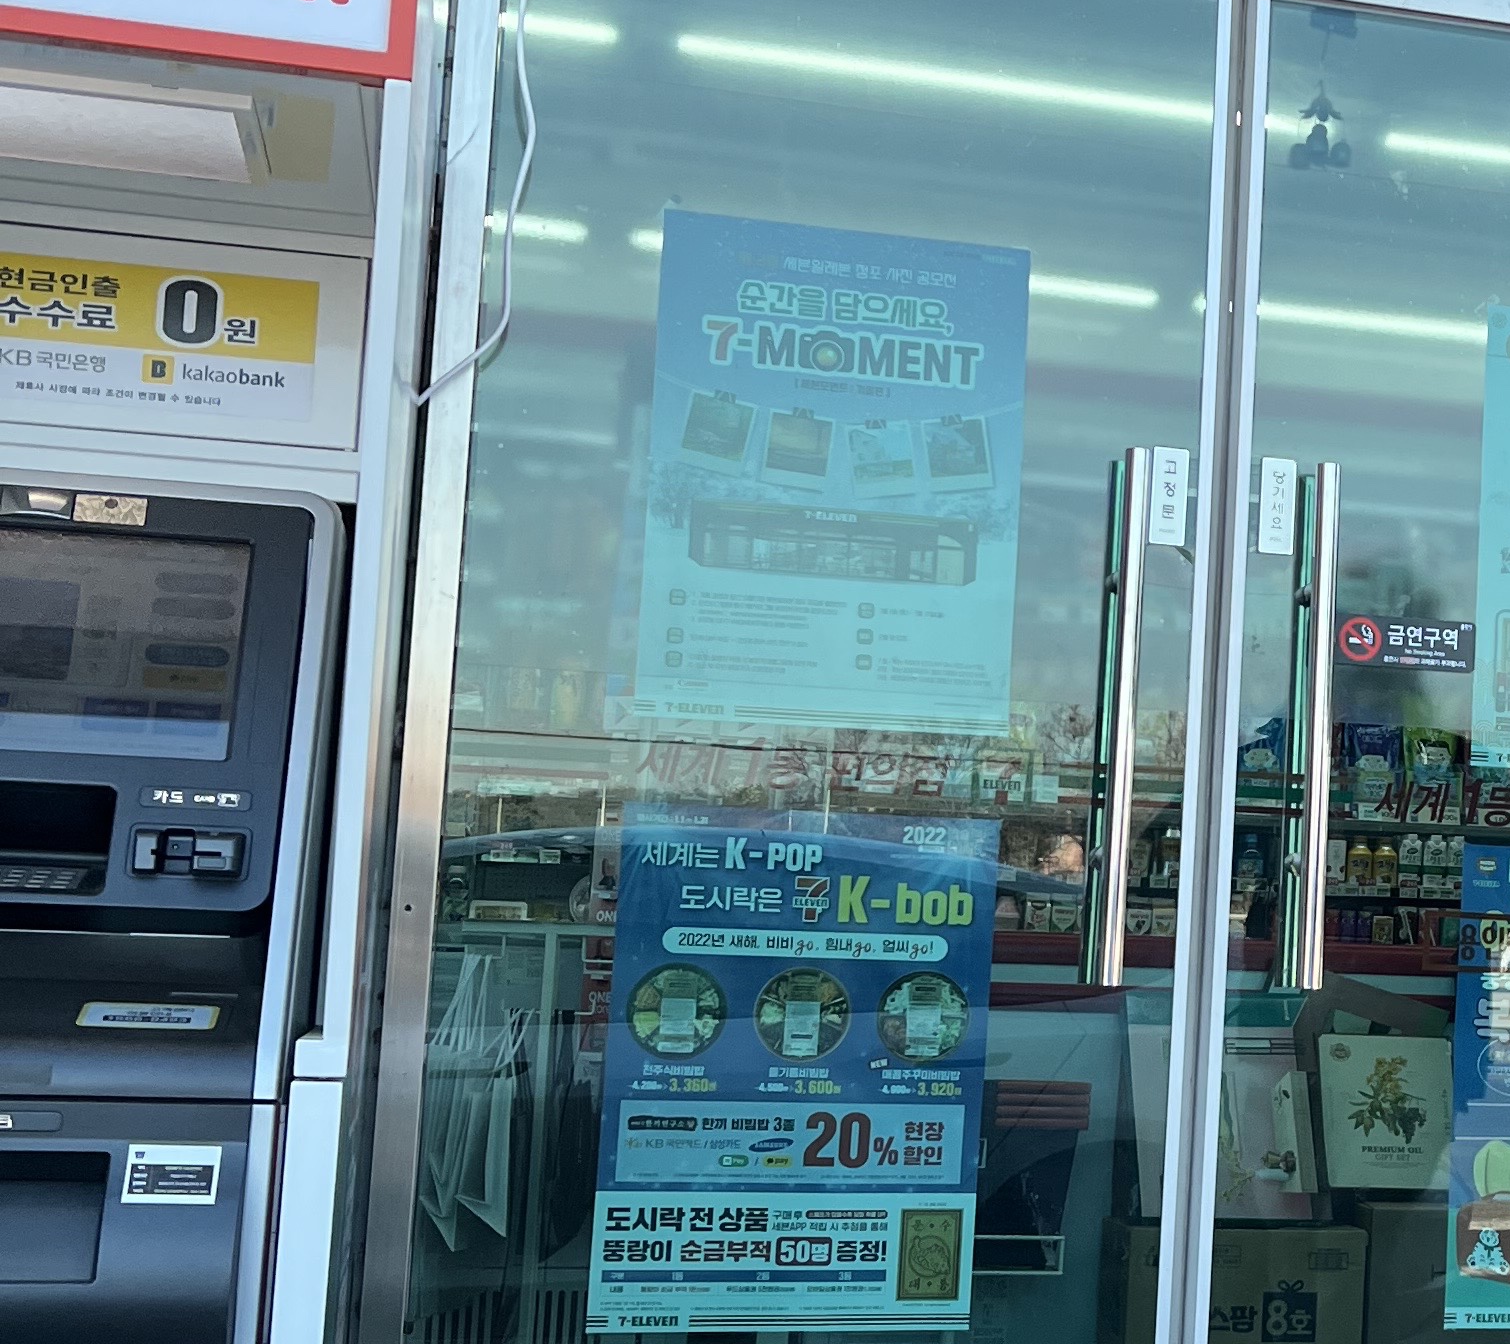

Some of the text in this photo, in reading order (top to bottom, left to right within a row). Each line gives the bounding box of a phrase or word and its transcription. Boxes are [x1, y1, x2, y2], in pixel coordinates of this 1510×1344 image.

[0, 267, 120, 298] 현금인출
[783, 257, 851, 278] 세븐일레븐
[885, 267, 912, 284] 사진
[0, 296, 115, 328] 수수료
[163, 280, 256, 344] 0원
[739, 280, 953, 336] 순간을 담으세요,
[37, 352, 106, 373] 국민은행
[182, 363, 285, 388] kakaobank
[170, 393, 179, 403] 수
[1162, 459, 1178, 520] 고정문
[1270, 470, 1287, 531] 당기세요
[1387, 624, 1459, 651] 금연구역
[152, 789, 184, 804] 카드
[1374, 782, 1450, 824] 세계
[903, 825, 946, 845] 2022
[641, 836, 823, 872] 세계는 K-POP
[679, 875, 974, 926] 도시락은 K-bob
[678, 931, 724, 948] 2022년
[731, 1118, 770, 1131] 비빔밥
[904, 1120, 945, 1142] 현장
[645, 1139, 664, 1149] KB
[803, 1111, 899, 1169] 20%
[1361, 1145, 1424, 1154] PREMIUM OIL
[903, 1145, 944, 1166] 할인
[605, 1207, 769, 1233] 도시락 전 상품
[772, 1222, 806, 1232] 세븐APP
[809, 1222, 827, 1232] 적립
[830, 1222, 839, 1232] 시
[603, 1239, 887, 1263] 뚱랑이 순금부적 50명 증정!
[1210, 1304, 1258, 1333] 스팜
[1267, 1299, 1314, 1336] 8호
